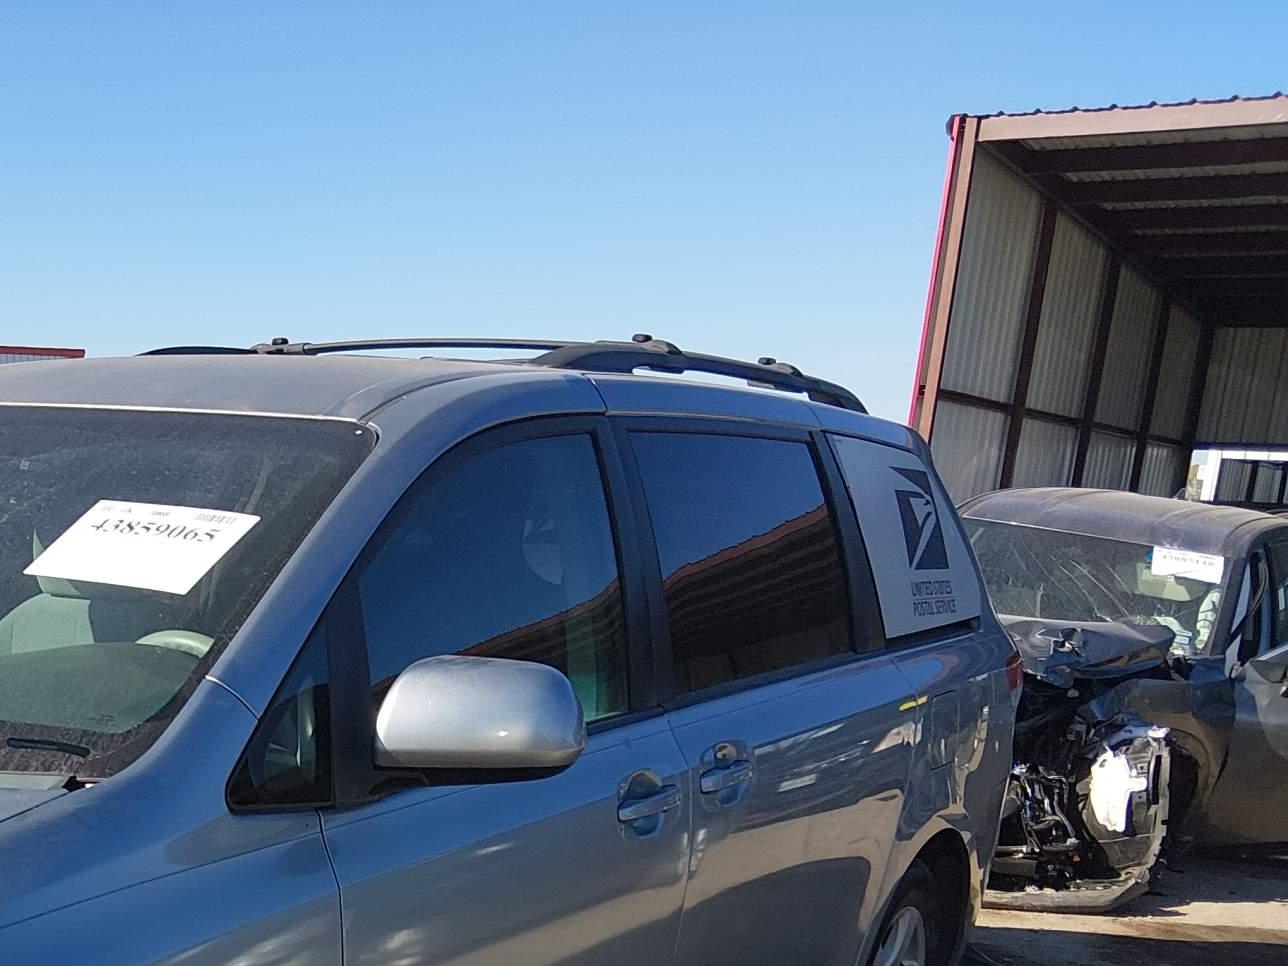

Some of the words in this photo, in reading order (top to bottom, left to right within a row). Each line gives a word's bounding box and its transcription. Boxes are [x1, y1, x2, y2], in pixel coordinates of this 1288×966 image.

[91, 517, 221, 543] 43859065
[911, 580, 933, 597] UNITED
[933, 580, 953, 595] STATES
[913, 600, 935, 617] POSTAL
[935, 599, 957, 615] SERVICE
